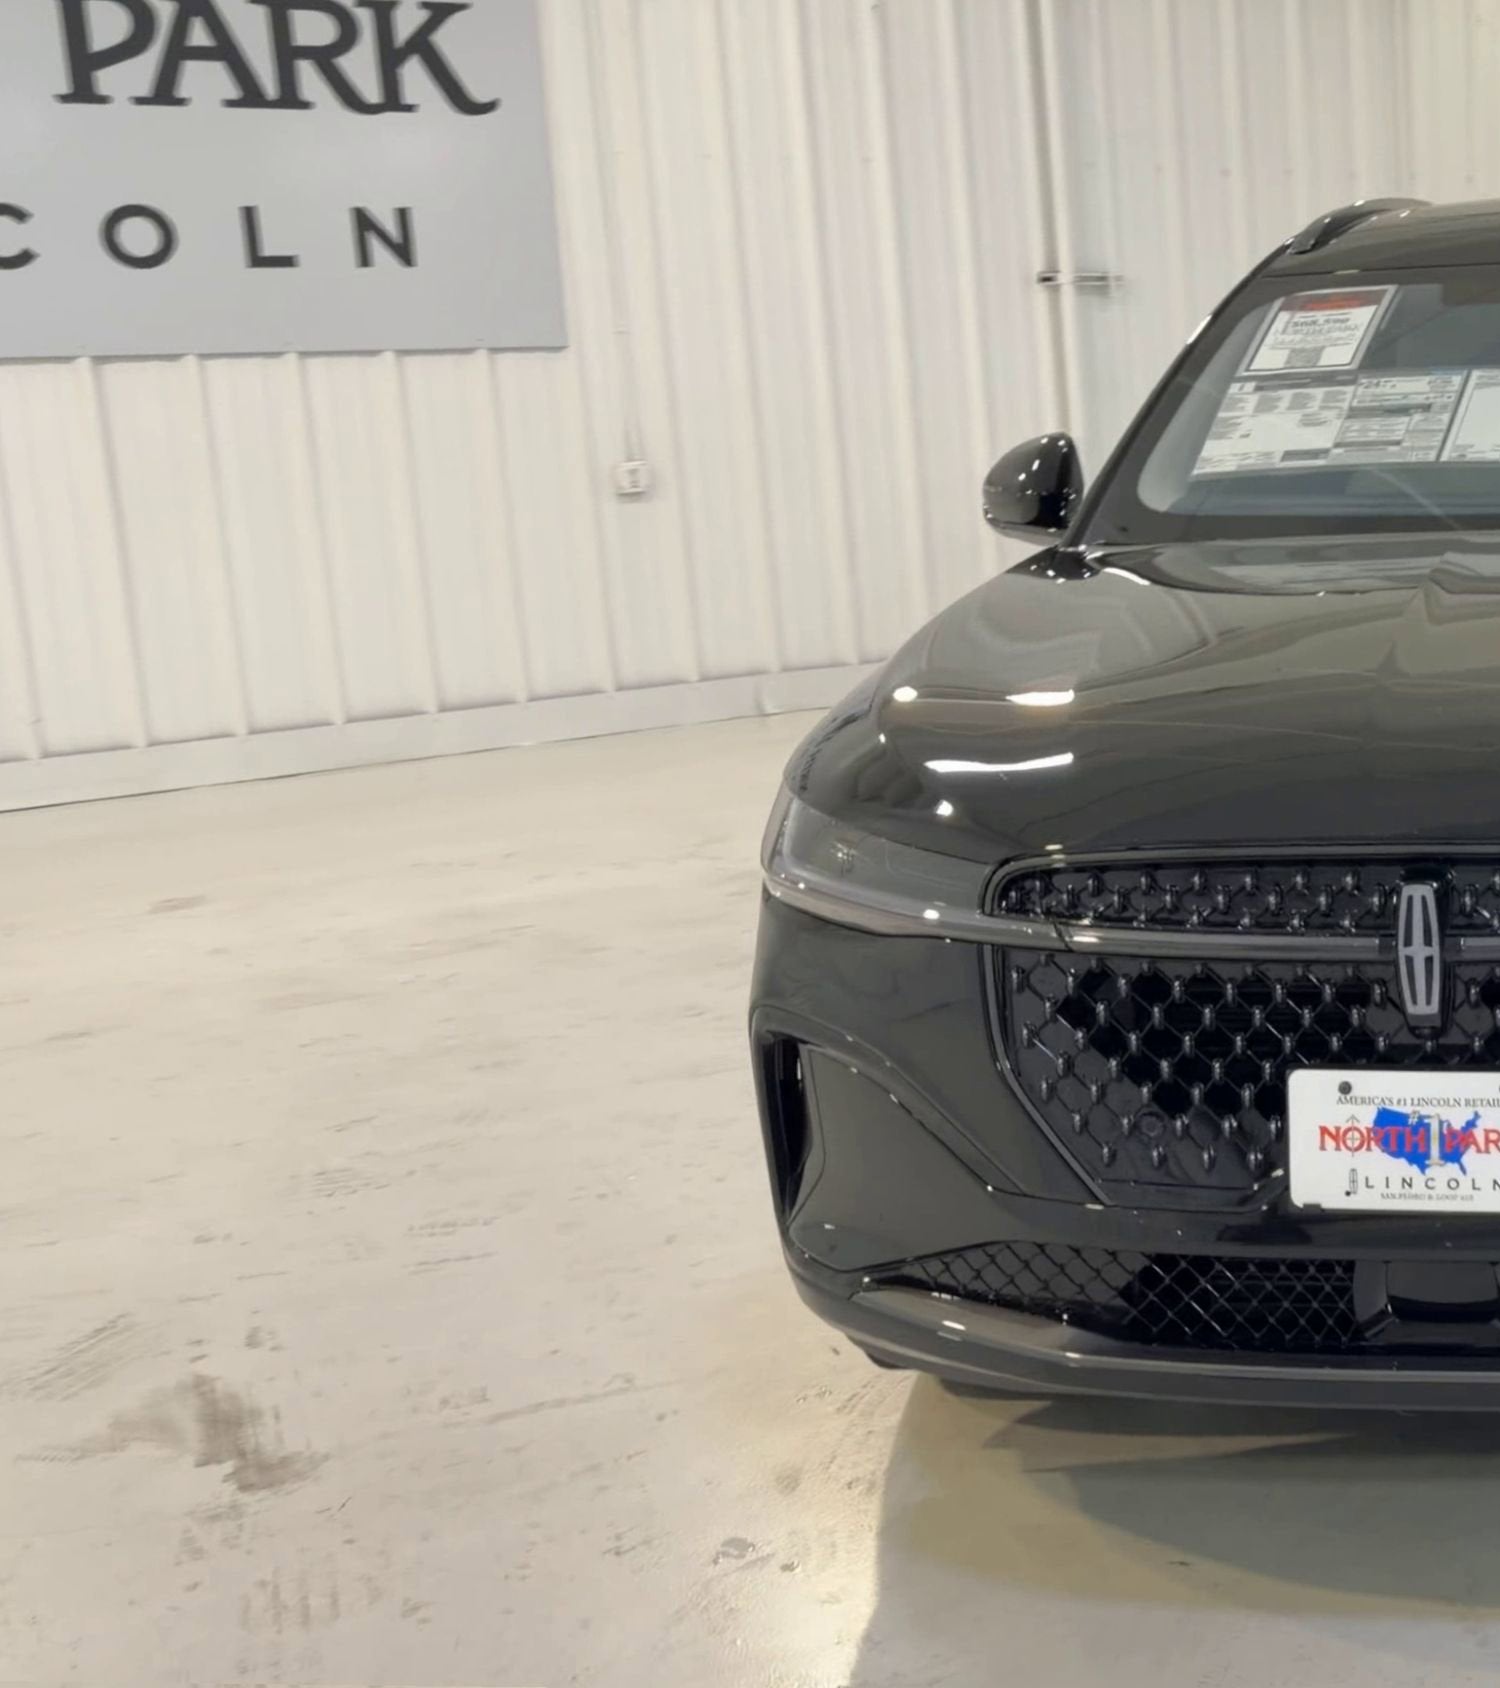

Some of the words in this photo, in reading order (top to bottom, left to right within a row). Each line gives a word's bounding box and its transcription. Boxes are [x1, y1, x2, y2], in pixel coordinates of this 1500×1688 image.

[53, 0, 501, 115] PARK
[1336, 1096, 1394, 1106] AMERICA'S
[1410, 1097, 1462, 1108] LINCOLN
[1318, 1126, 1427, 1152] NORTH
